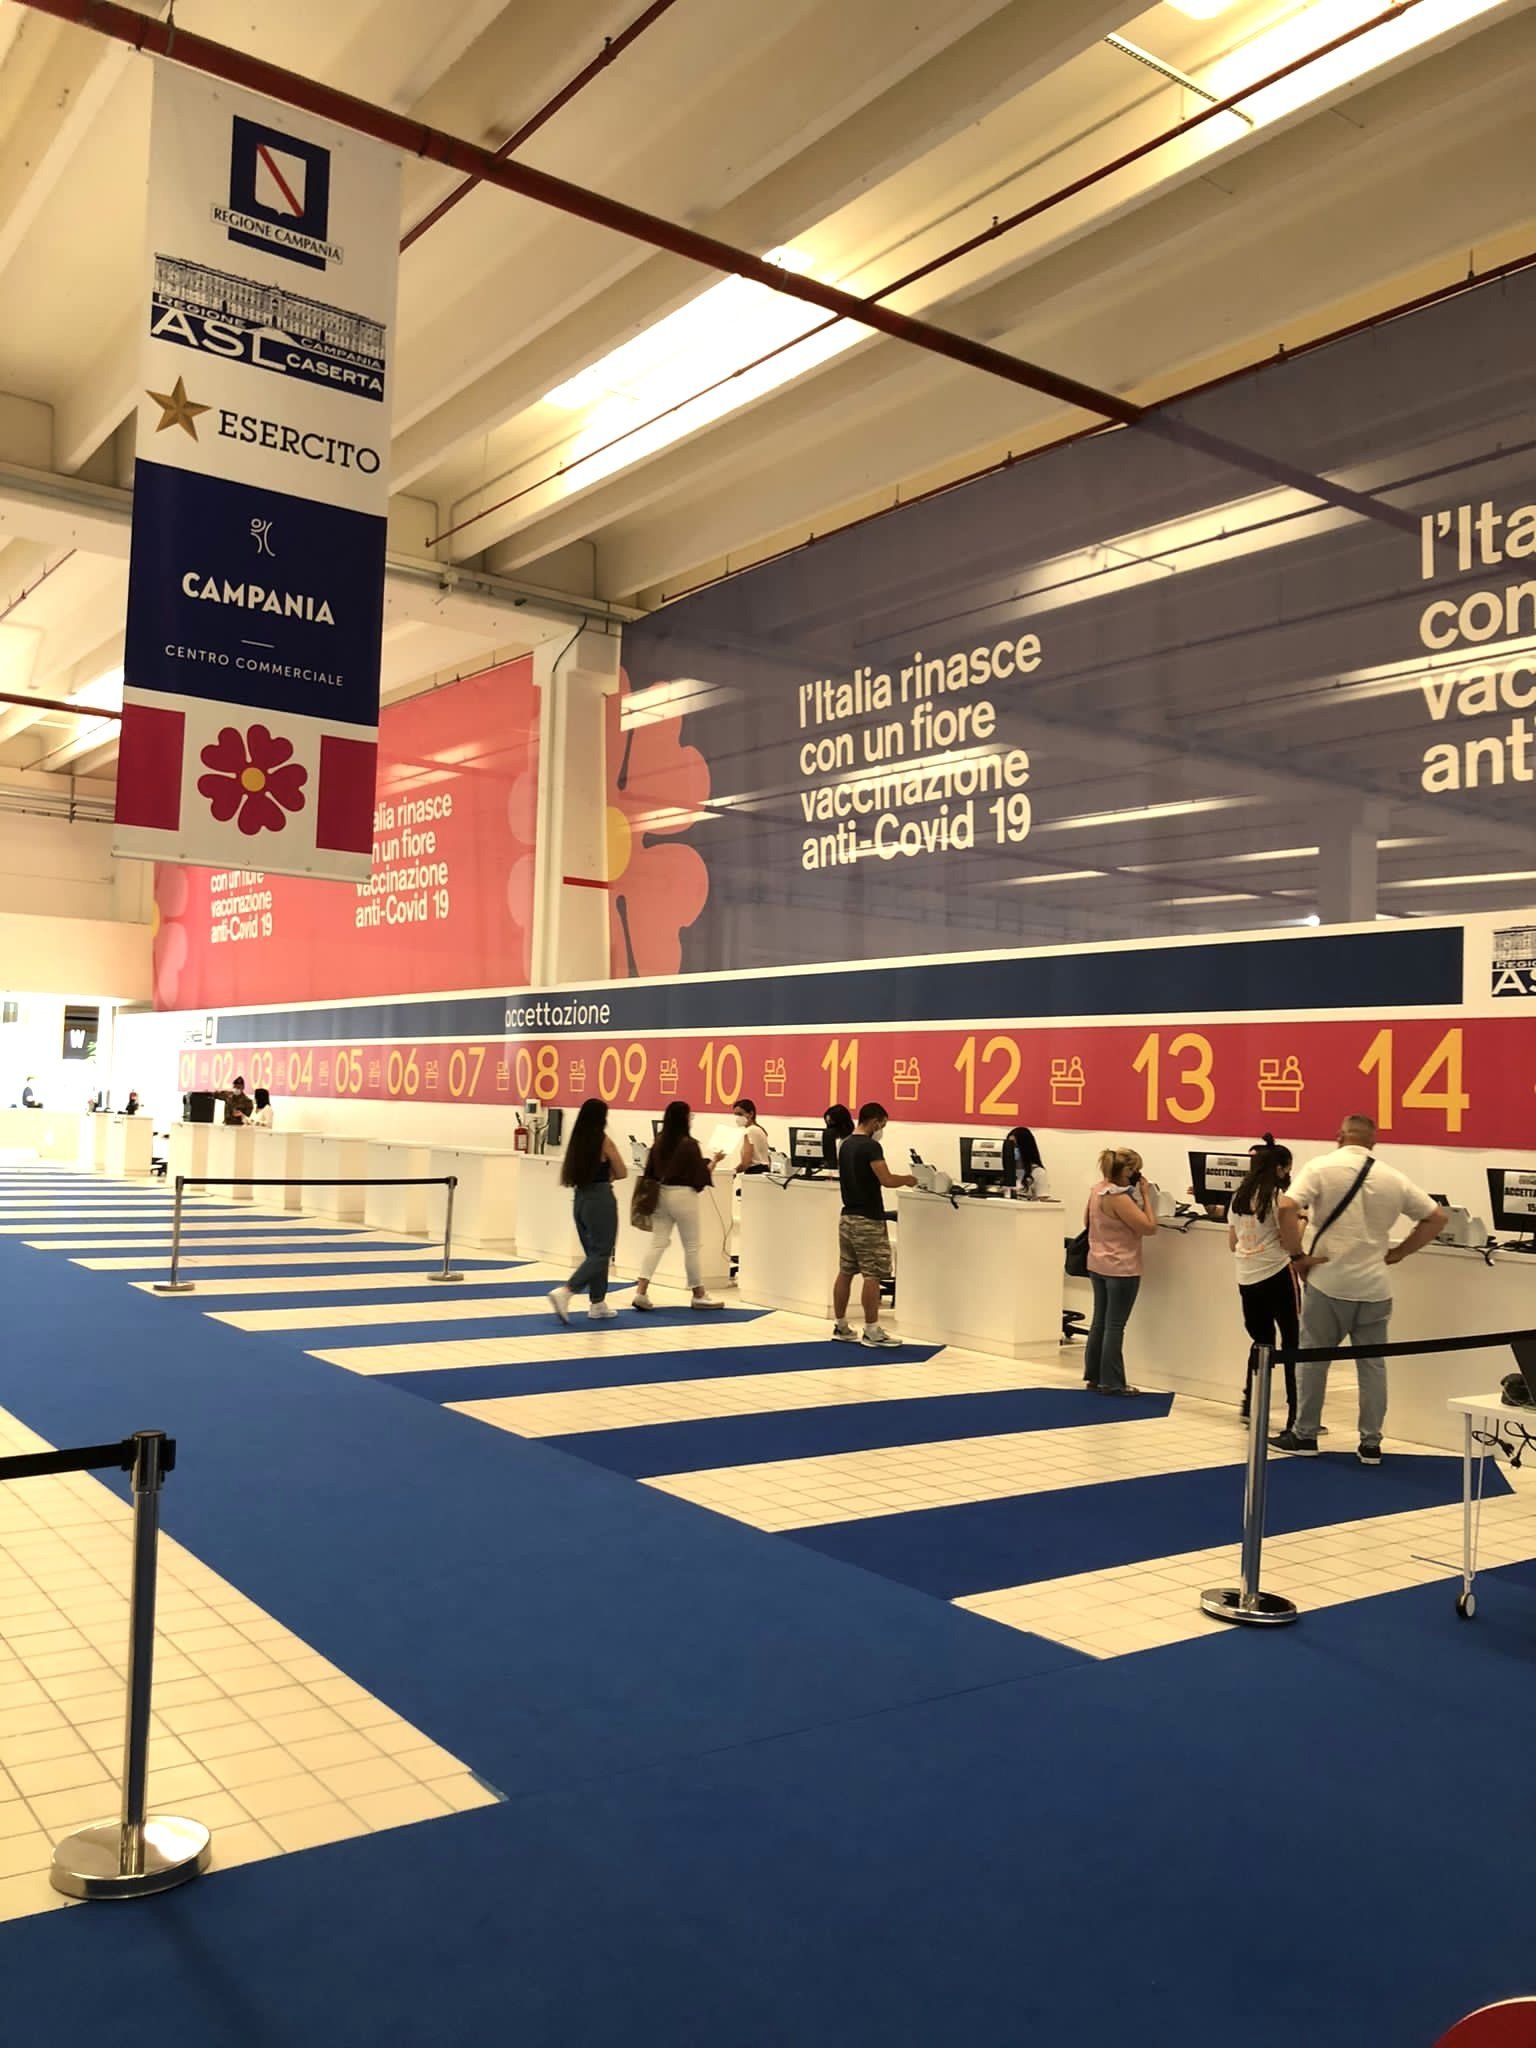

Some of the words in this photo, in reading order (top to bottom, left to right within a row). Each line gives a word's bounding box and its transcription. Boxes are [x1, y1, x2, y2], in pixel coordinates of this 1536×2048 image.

[213, 207, 272, 237] REGIONE
[274, 228, 341, 260] CAMPANIA
[151, 308, 287, 371] ASL
[286, 352, 383, 393] CASERTA
[158, 295, 248, 330] REGIONE
[300, 337, 382, 369] CAMPANIA
[218, 408, 381, 475] ESERCITO
[182, 571, 336, 626] CAMPANIA
[165, 643, 230, 667] CENTRO
[235, 656, 344, 687] COMMERCIALE
[799, 666, 893, 729] l'Italia
[901, 633, 1042, 703] rinasce
[800, 732, 854, 776] con
[863, 721, 905, 763] un
[911, 701, 997, 752] fiore
[397, 793, 453, 827] rinasce
[800, 749, 1031, 823] vaccinazione
[381, 838, 400, 863] un
[402, 827, 437, 858] fiore
[802, 800, 975, 871] anti-Covid
[989, 792, 1032, 845] 19
[356, 859, 449, 897] vaccinazione
[261, 912, 273, 937] 19
[355, 891, 428, 928] anti-Covid
[433, 888, 450, 919] 19
[1492, 969, 1536, 995] A
[505, 999, 611, 1029] accettazione
[212, 1051, 234, 1090] 02
[250, 1051, 273, 1091] 03
[288, 1050, 313, 1093] 04
[335, 1048, 364, 1093] 05
[387, 1047, 420, 1096] 06
[448, 1046, 486, 1098] 07
[515, 1044, 559, 1100] 08
[598, 1043, 647, 1102] 09
[698, 1041, 743, 1106] 10
[821, 1038, 859, 1110] 11
[953, 1035, 1022, 1116] 12
[1132, 1032, 1216, 1124] 13
[1357, 1027, 1470, 1133] 14
